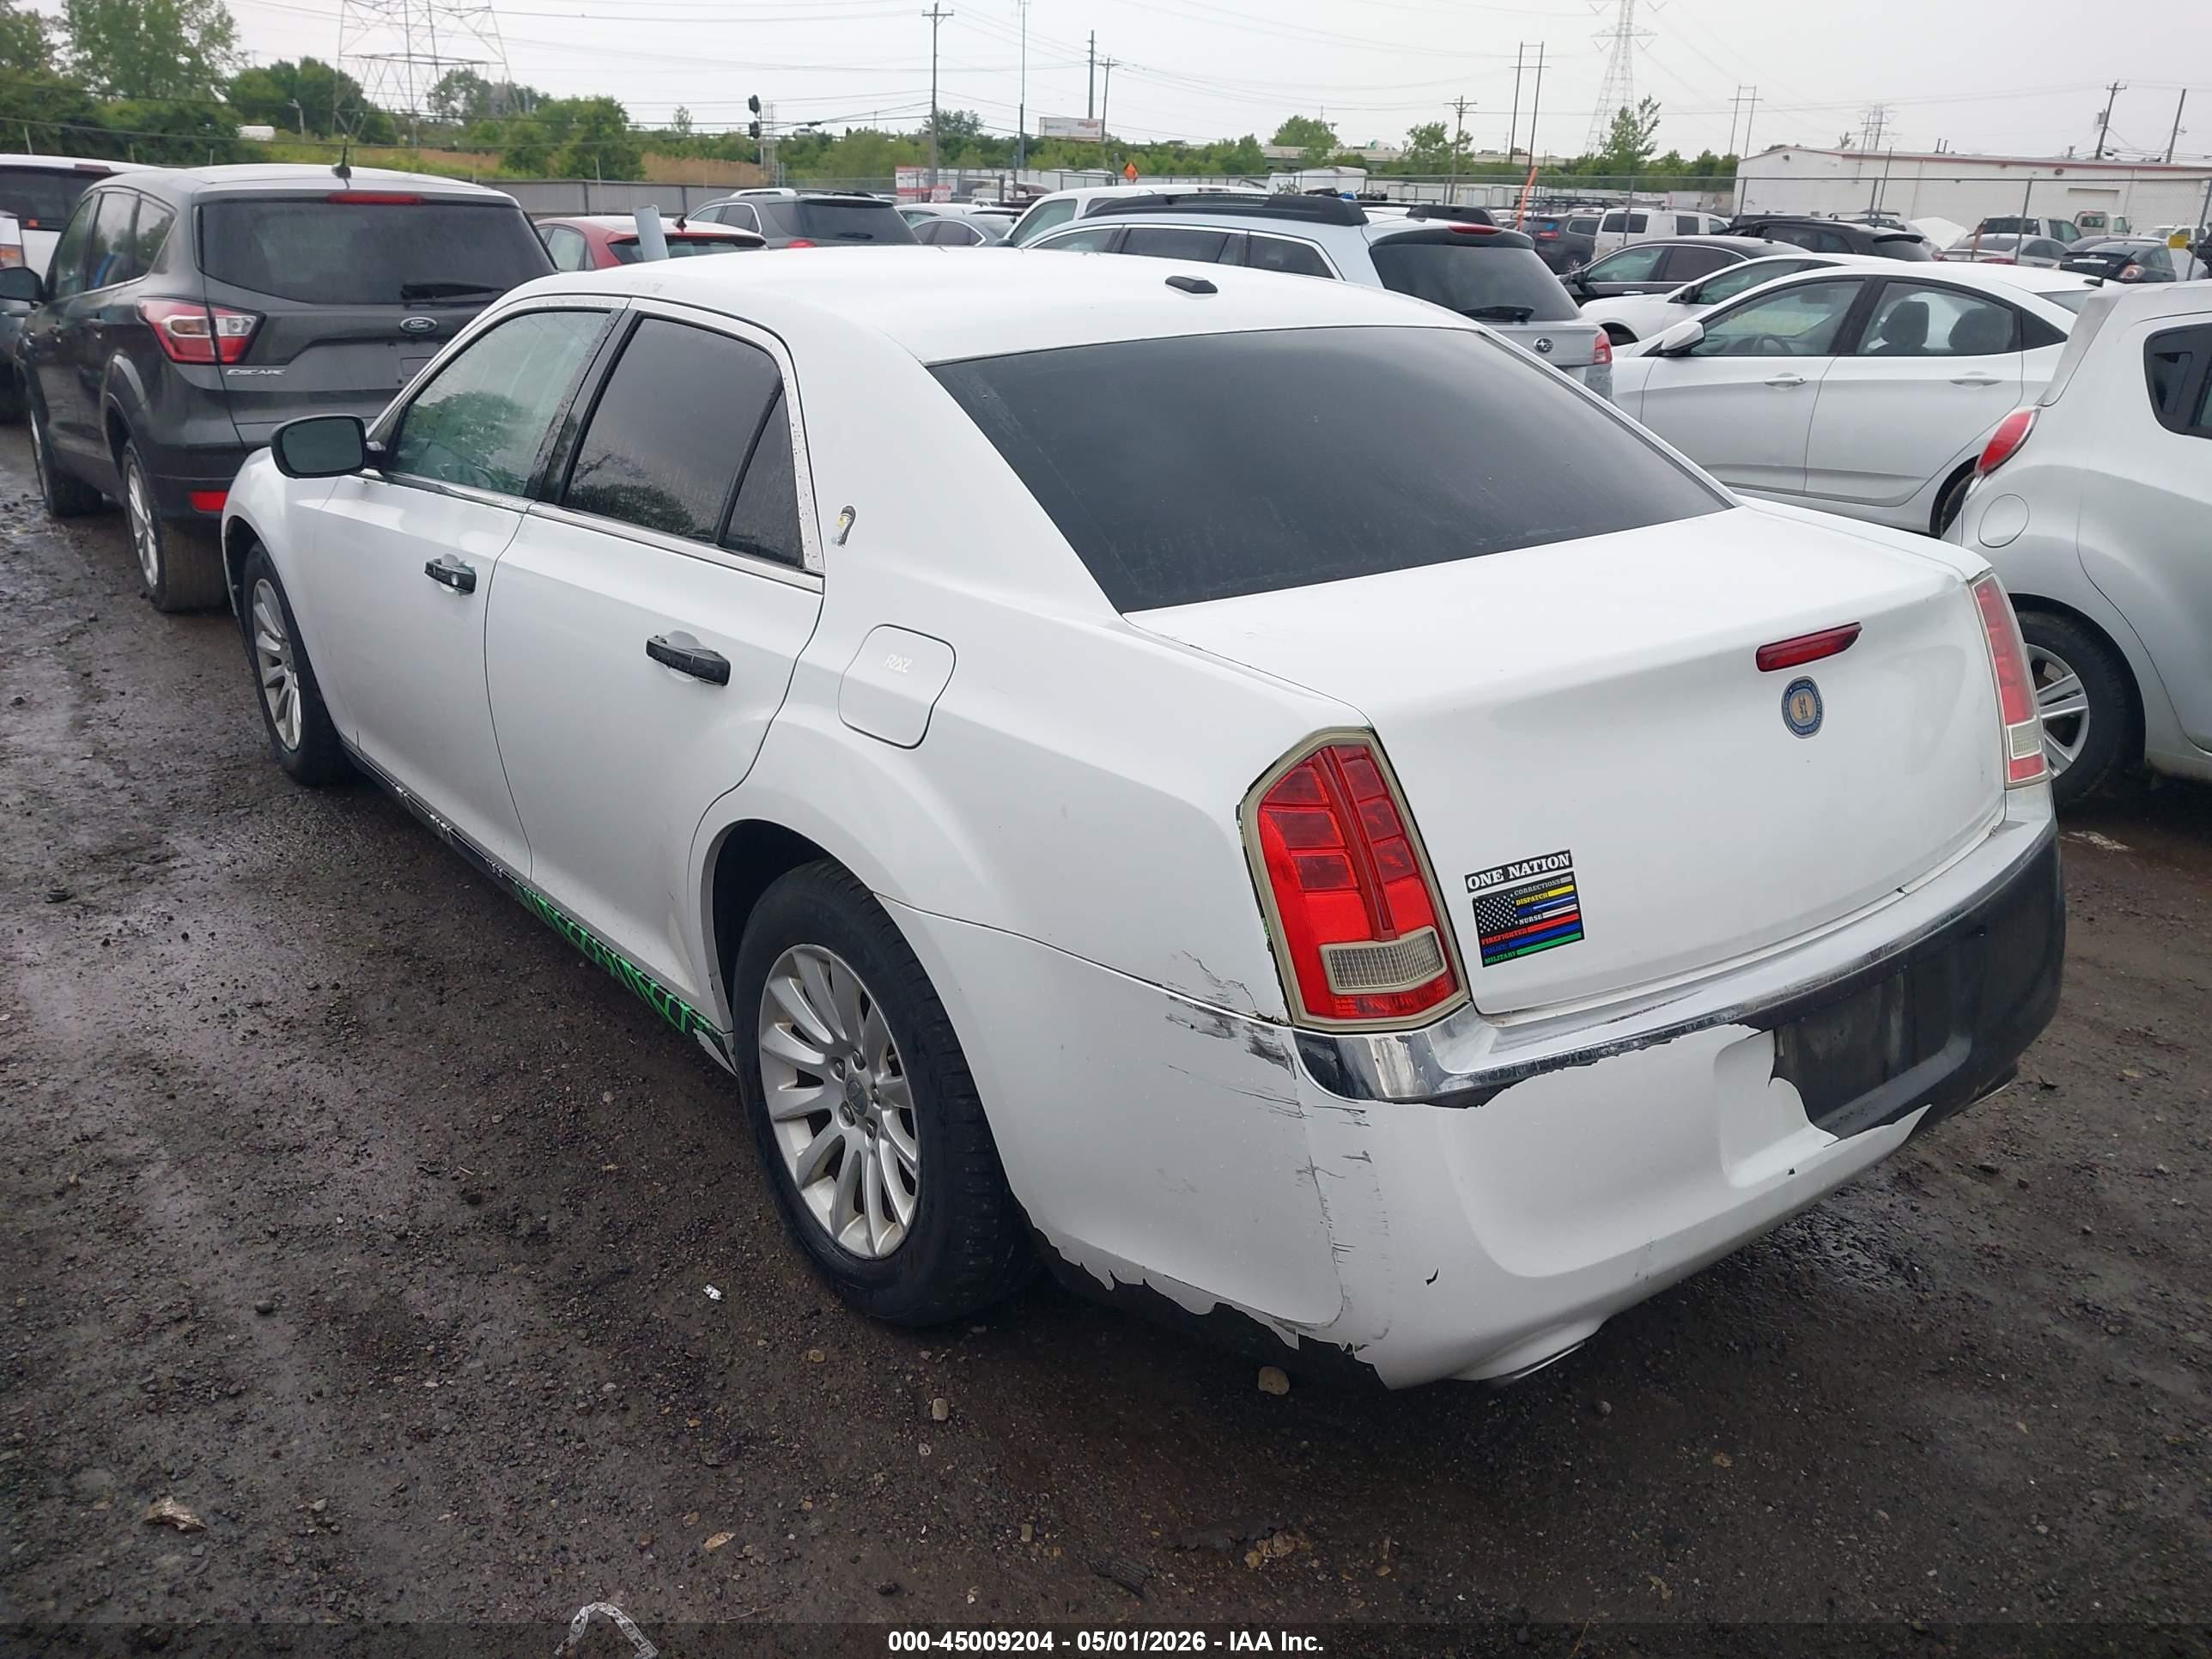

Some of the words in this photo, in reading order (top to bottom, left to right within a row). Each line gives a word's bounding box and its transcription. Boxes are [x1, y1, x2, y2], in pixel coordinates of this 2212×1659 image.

[1467, 868, 1504, 890] ONE
[1507, 853, 1570, 878] NATION
[1514, 878, 1560, 896] CORRECTIONS
[1516, 892, 1548, 906] DISPATCH
[1519, 914, 1543, 925] NURSE
[1481, 927, 1528, 945] FIREFIGHTER
[1485, 951, 1516, 964] MILITARY
